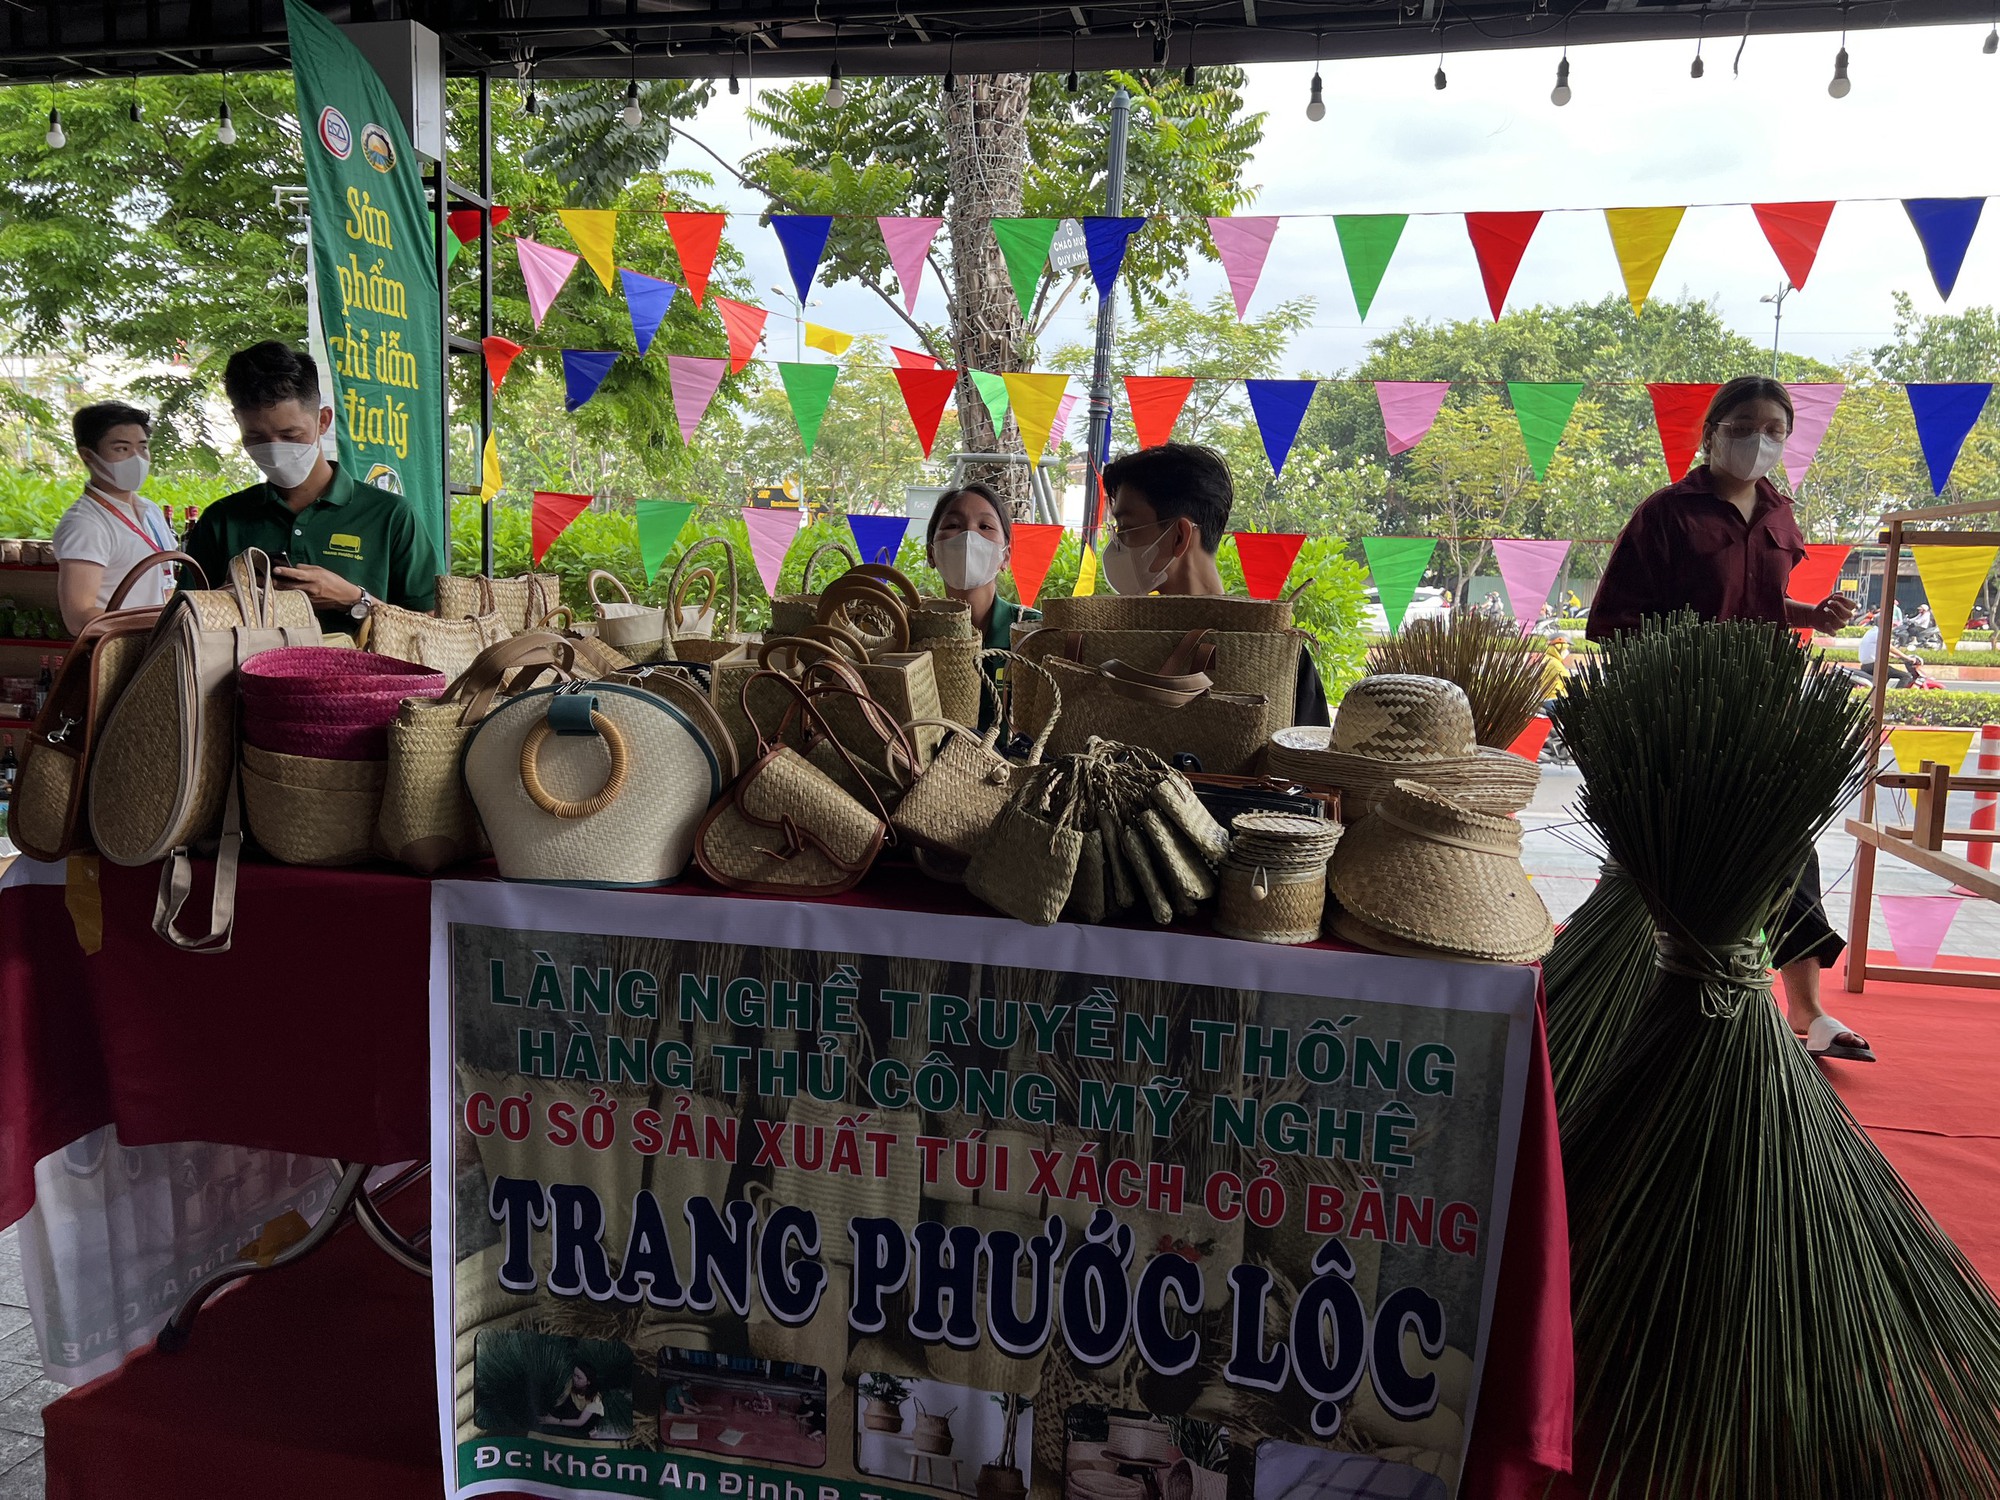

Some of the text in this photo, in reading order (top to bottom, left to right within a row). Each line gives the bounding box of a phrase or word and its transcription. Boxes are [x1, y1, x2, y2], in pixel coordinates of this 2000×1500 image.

[345, 186, 393, 250] Sản
[336, 253, 408, 320] phẩm
[329, 323, 419, 390] chỉ dẫn
[385, 394, 410, 460] lý
[488, 950, 1458, 1098] LÀNG NGHỀ TRUYỀN THỐNG
[516, 1019, 1420, 1178] HÀNG THỦ CÔNG MỸ NGHỆ
[464, 1087, 1482, 1259] CƠ SỞ SẢN XUẤT TÚI XÁCH CỎ BÀNG
[488, 1175, 1447, 1438] TRANG PHƯỚC LỘC
[473, 1445, 533, 1471] Đc:
[542, 1449, 648, 1483] Khóm
[658, 1461, 707, 1491] An
[717, 1471, 806, 1500] Định
